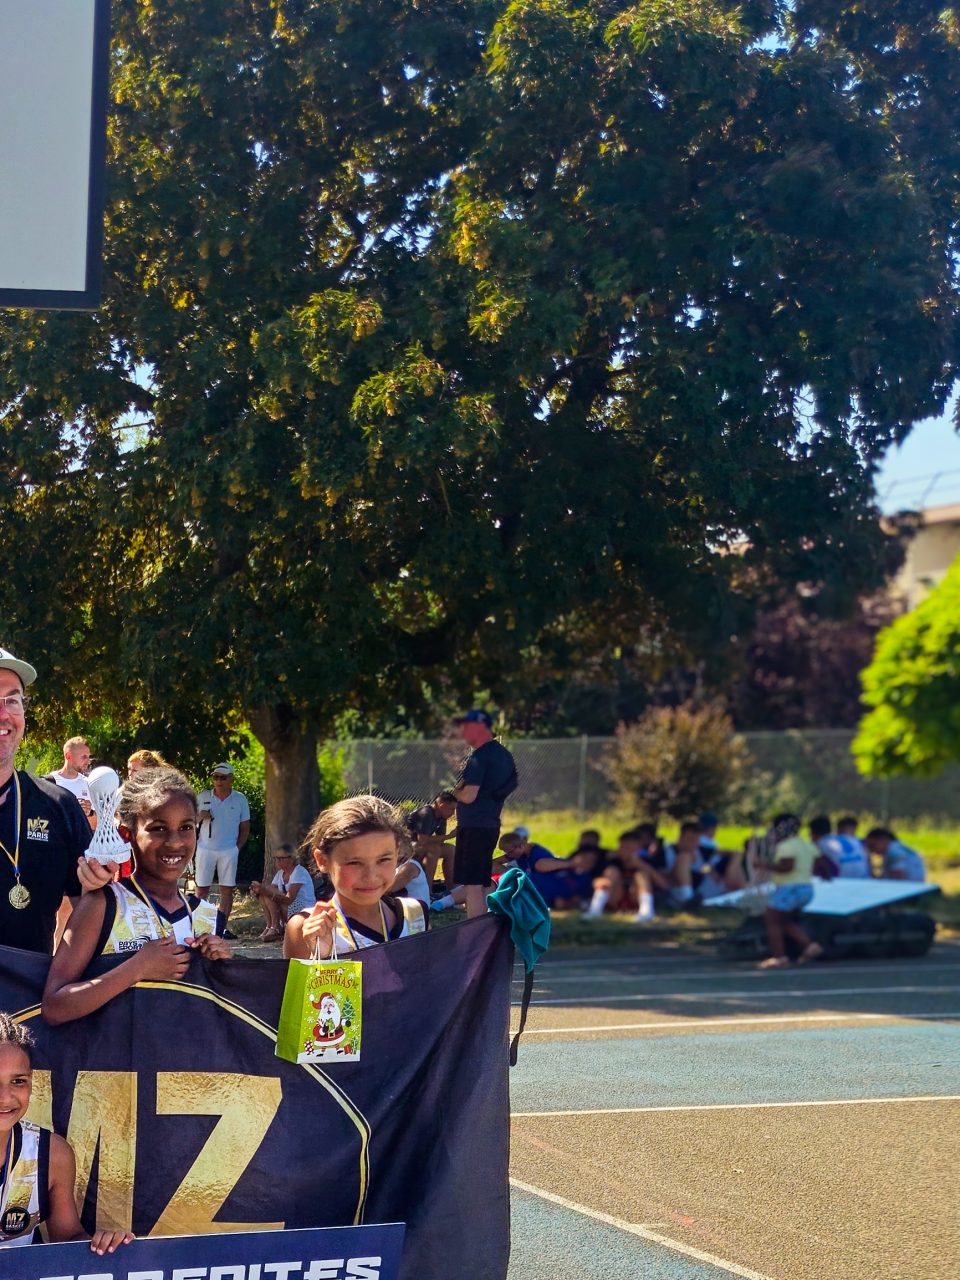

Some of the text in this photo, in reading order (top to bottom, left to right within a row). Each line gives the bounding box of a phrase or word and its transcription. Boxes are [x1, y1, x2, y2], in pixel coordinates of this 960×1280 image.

[27, 831, 48, 839] PARIS
[311, 975, 352, 989] CHRISTMAS
[7, 1212, 25, 1225] MZ
